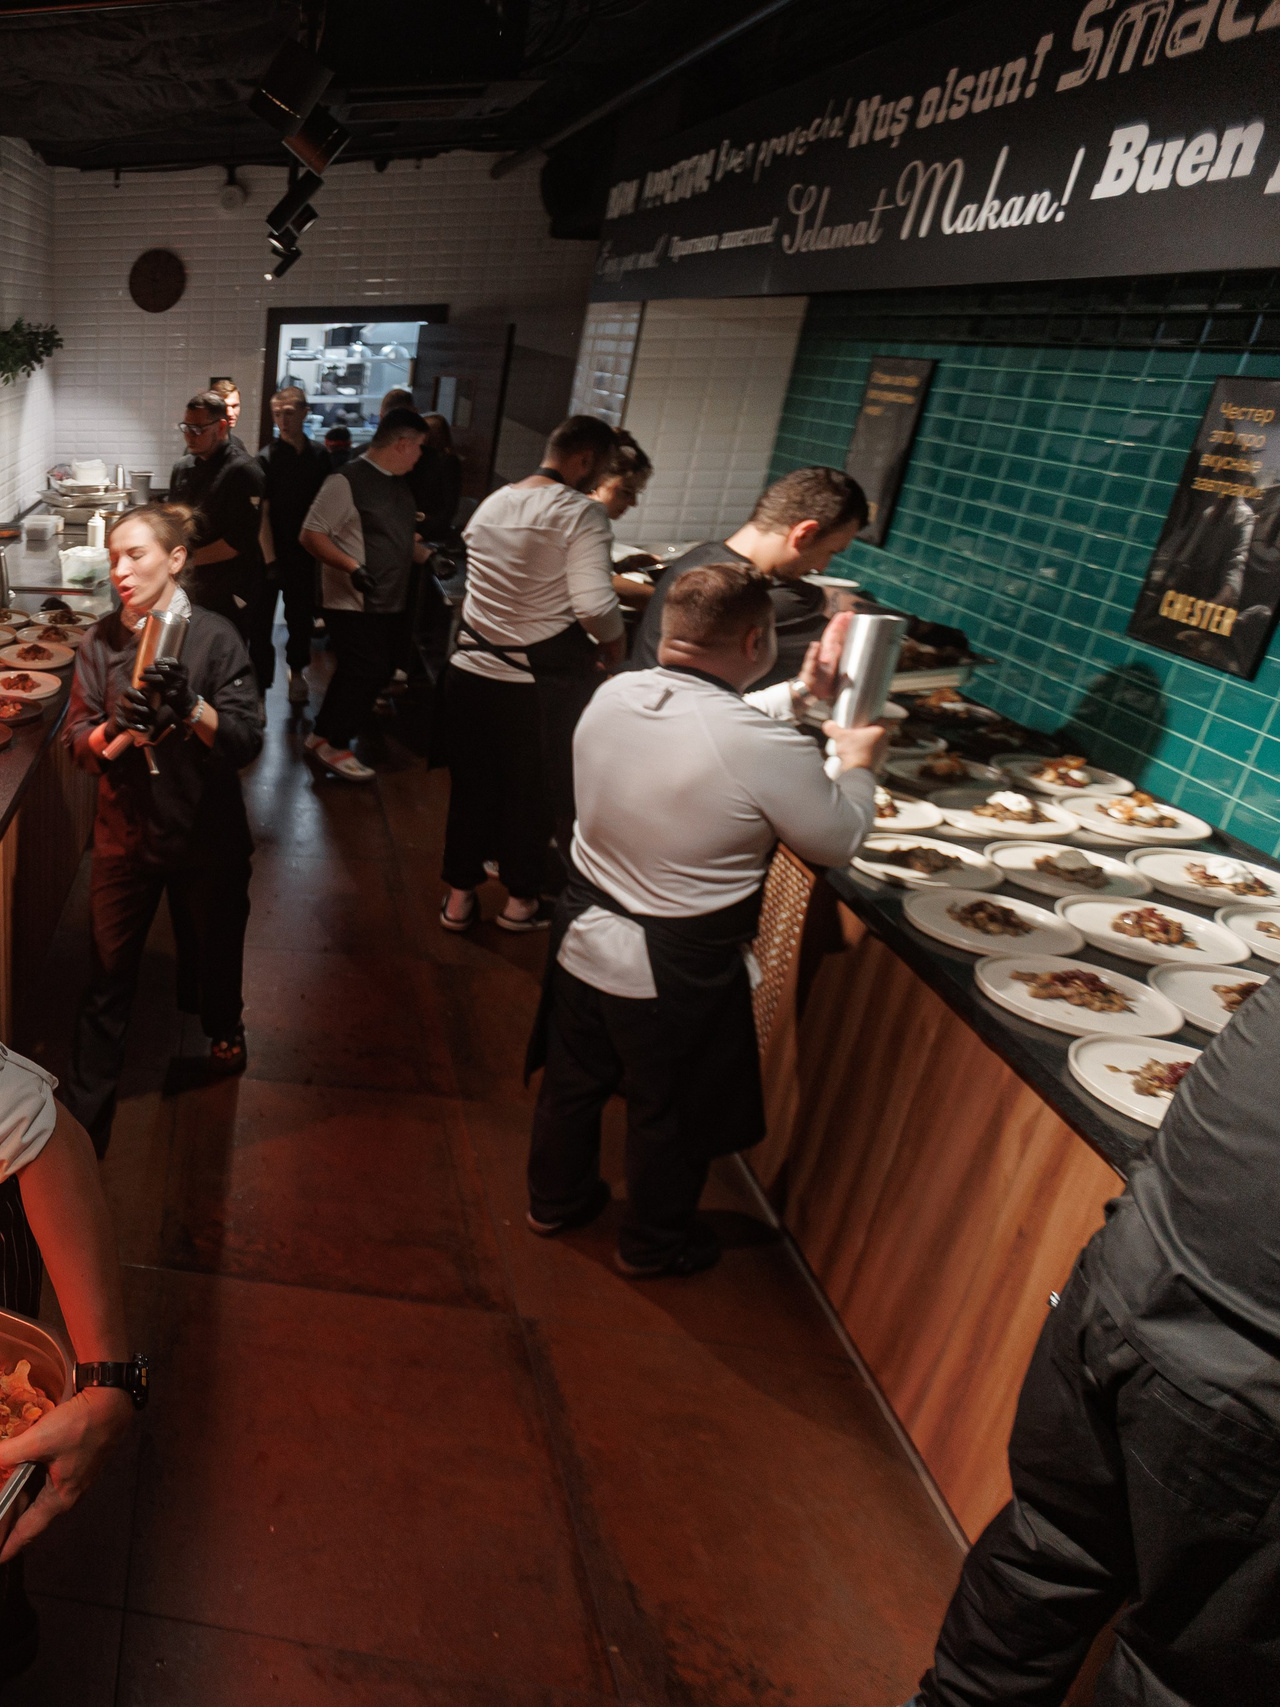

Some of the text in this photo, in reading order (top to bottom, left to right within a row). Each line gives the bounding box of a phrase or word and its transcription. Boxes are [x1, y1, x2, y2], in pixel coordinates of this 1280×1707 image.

[848, 33, 1054, 149] Nuş olsun!
[782, 184, 895, 254] Selamat
[896, 145, 1086, 240] Makan!
[1090, 121, 1265, 200] Buen
[1220, 401, 1275, 427] Честер
[1158, 590, 1238, 637] CHESTER
